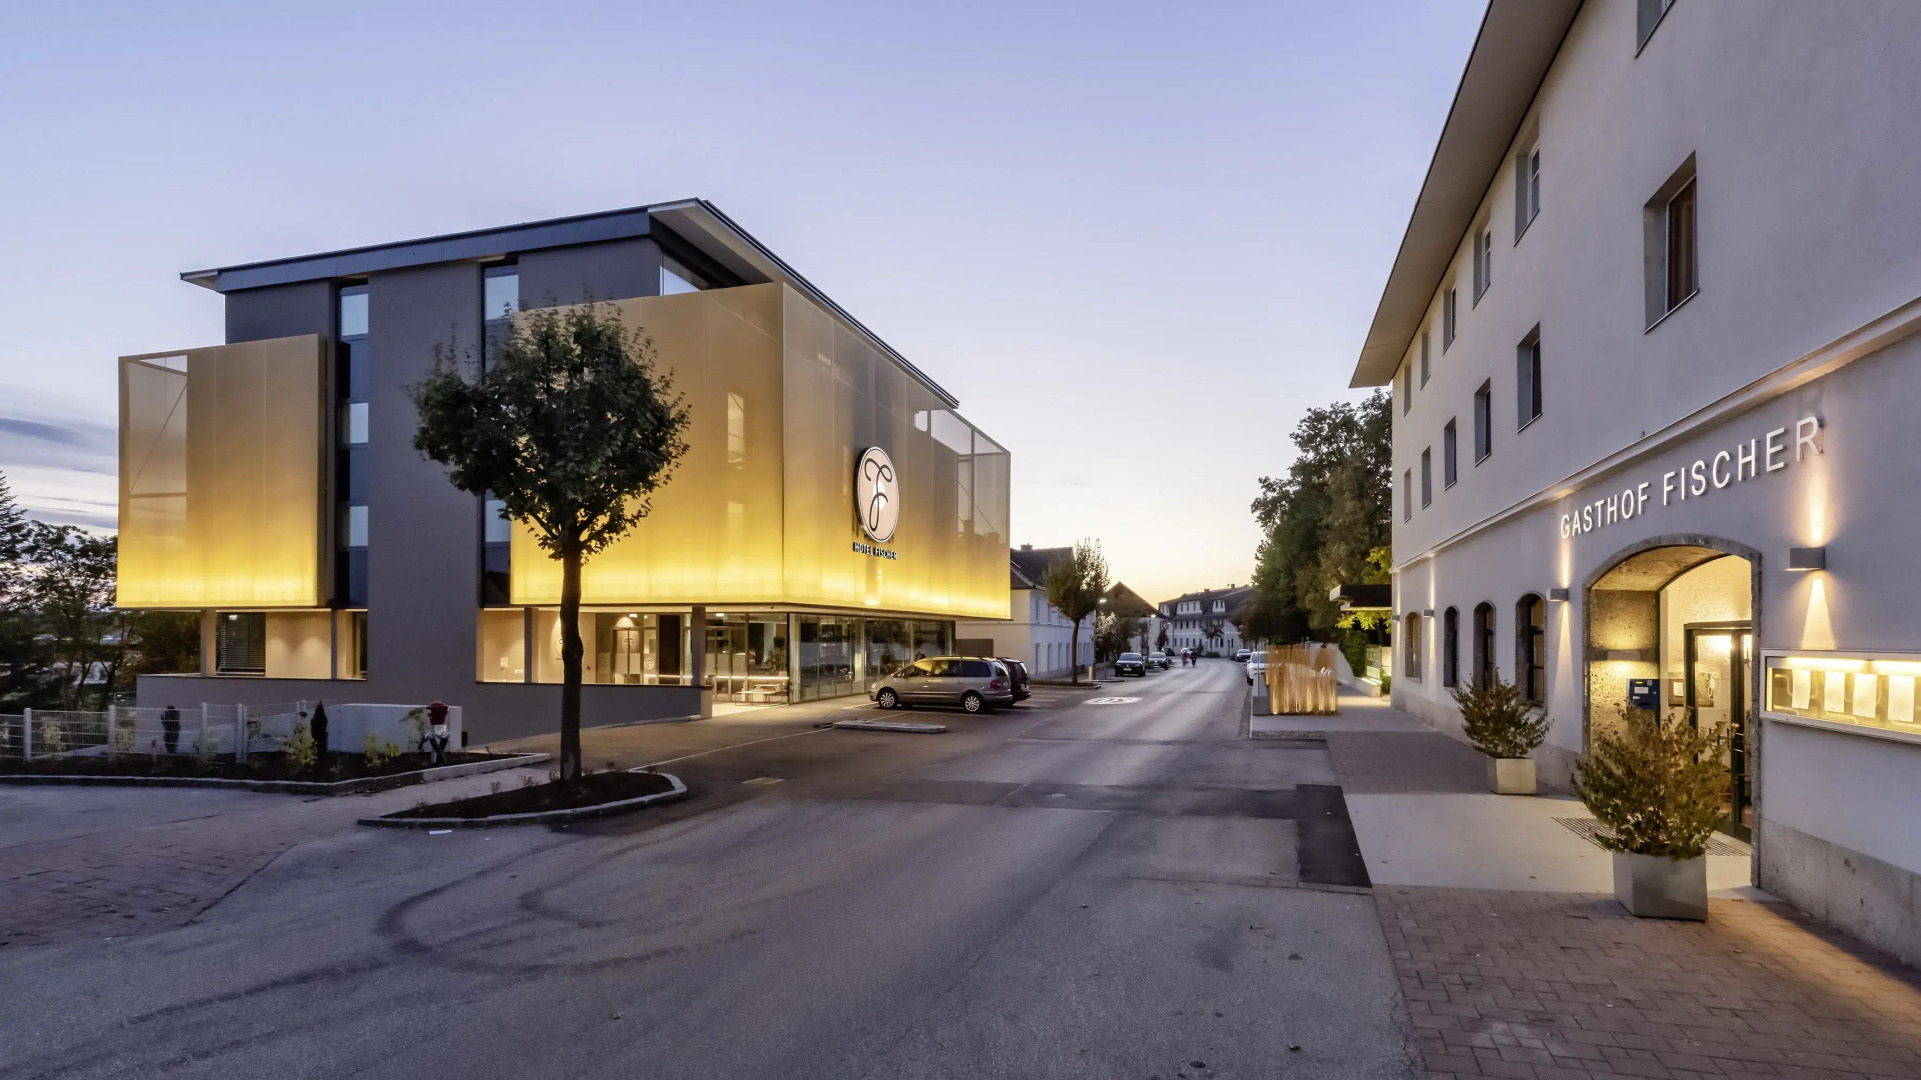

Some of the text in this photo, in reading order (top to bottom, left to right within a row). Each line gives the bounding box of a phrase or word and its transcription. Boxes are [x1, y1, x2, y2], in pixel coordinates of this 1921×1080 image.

[1560, 416, 1820, 539] GASTHOF FISCHER
[854, 542, 898, 560] HOTEL FISCHER
